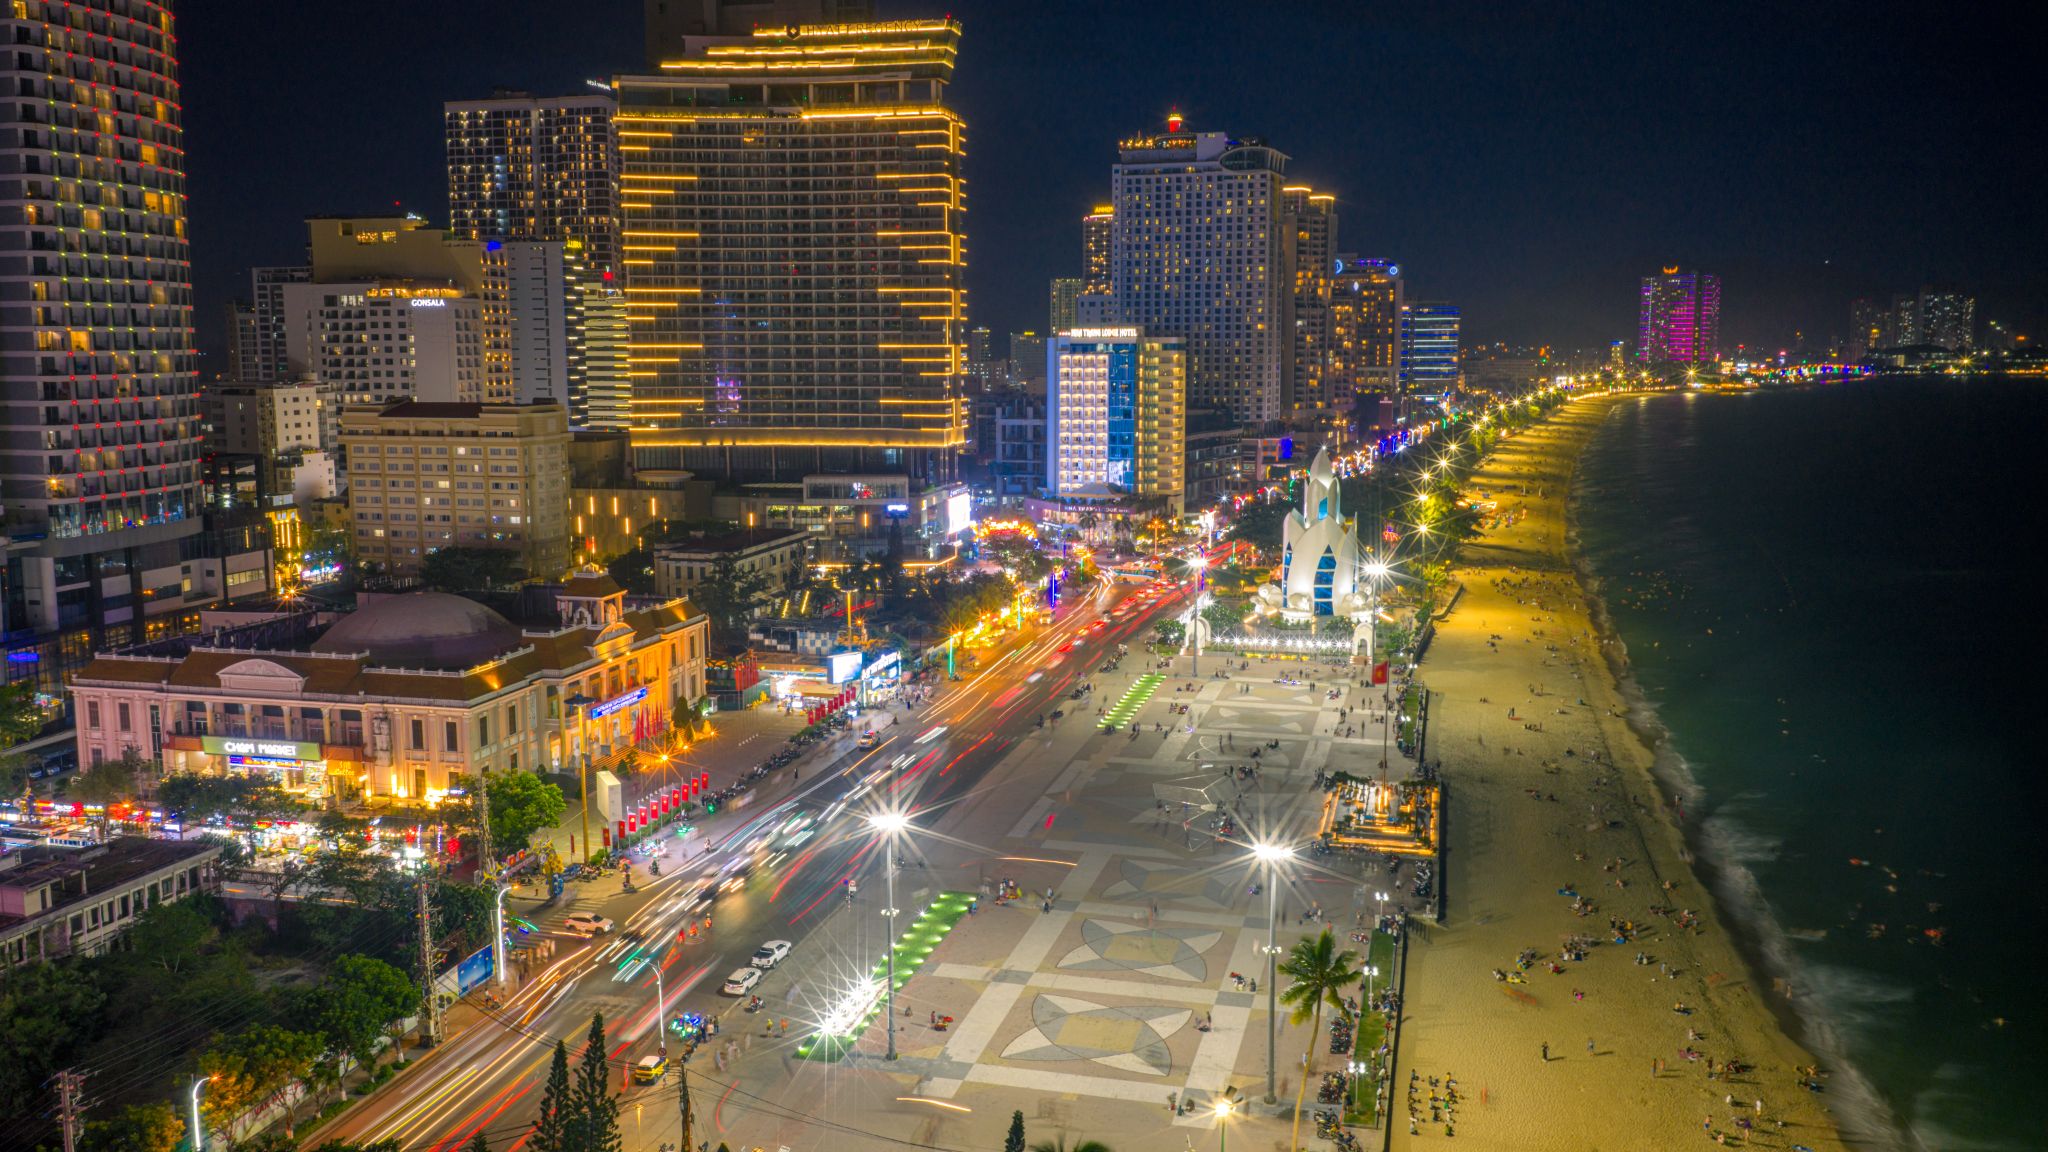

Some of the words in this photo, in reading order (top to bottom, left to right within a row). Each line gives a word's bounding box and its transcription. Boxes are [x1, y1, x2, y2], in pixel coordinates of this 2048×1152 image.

[807, 24, 850, 35] HYATT
[857, 22, 921, 33] REGENCY
[411, 299, 446, 307] GONSALA
[1119, 328, 1138, 337] HOTEL
[258, 744, 297, 755] MARKET
